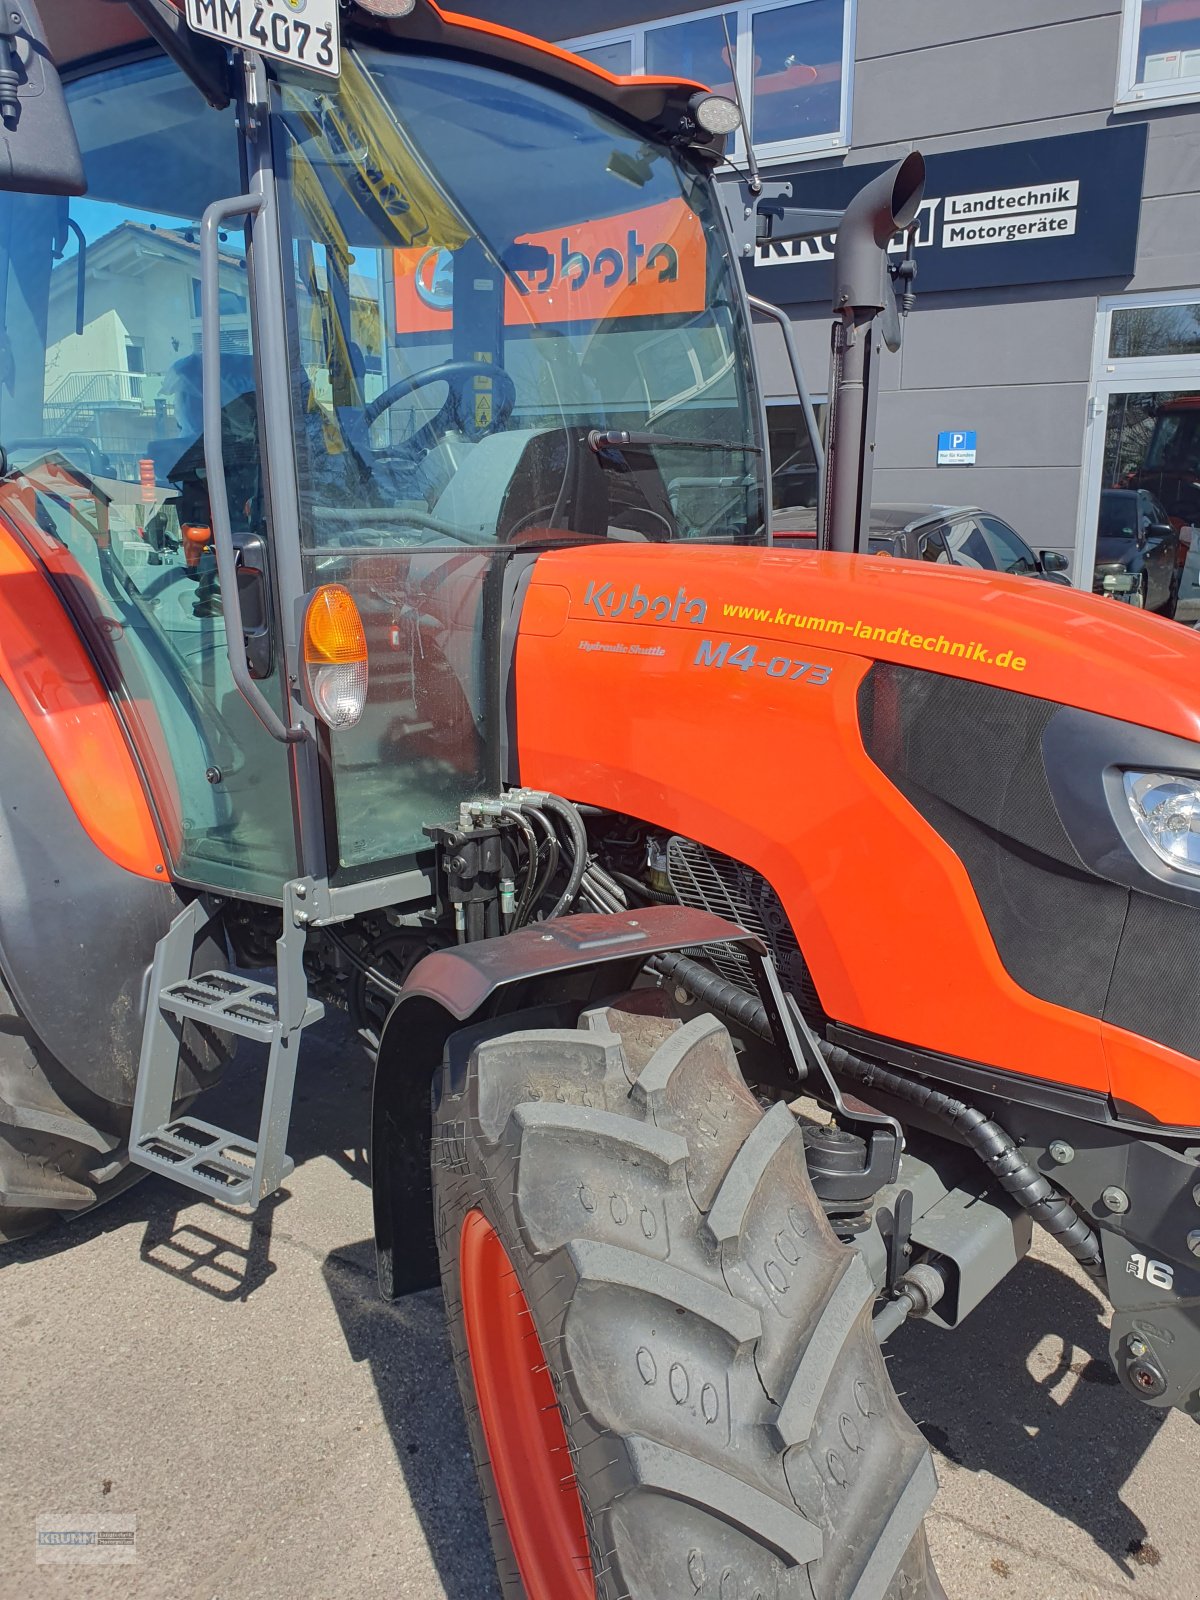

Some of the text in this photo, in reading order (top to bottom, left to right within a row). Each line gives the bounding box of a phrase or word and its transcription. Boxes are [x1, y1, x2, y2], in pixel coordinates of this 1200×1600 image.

[195, 0, 334, 67] MM 4073
[950, 186, 1070, 215] Landtechnik
[949, 215, 1069, 241] Motorgeräte
[953, 434, 964, 448] P
[584, 580, 708, 624] Kubota
[578, 640, 666, 656] Hydraulic Shuttle
[722, 603, 1027, 673] www.krumm-landtechnik.de
[693, 639, 833, 685] M4-073
